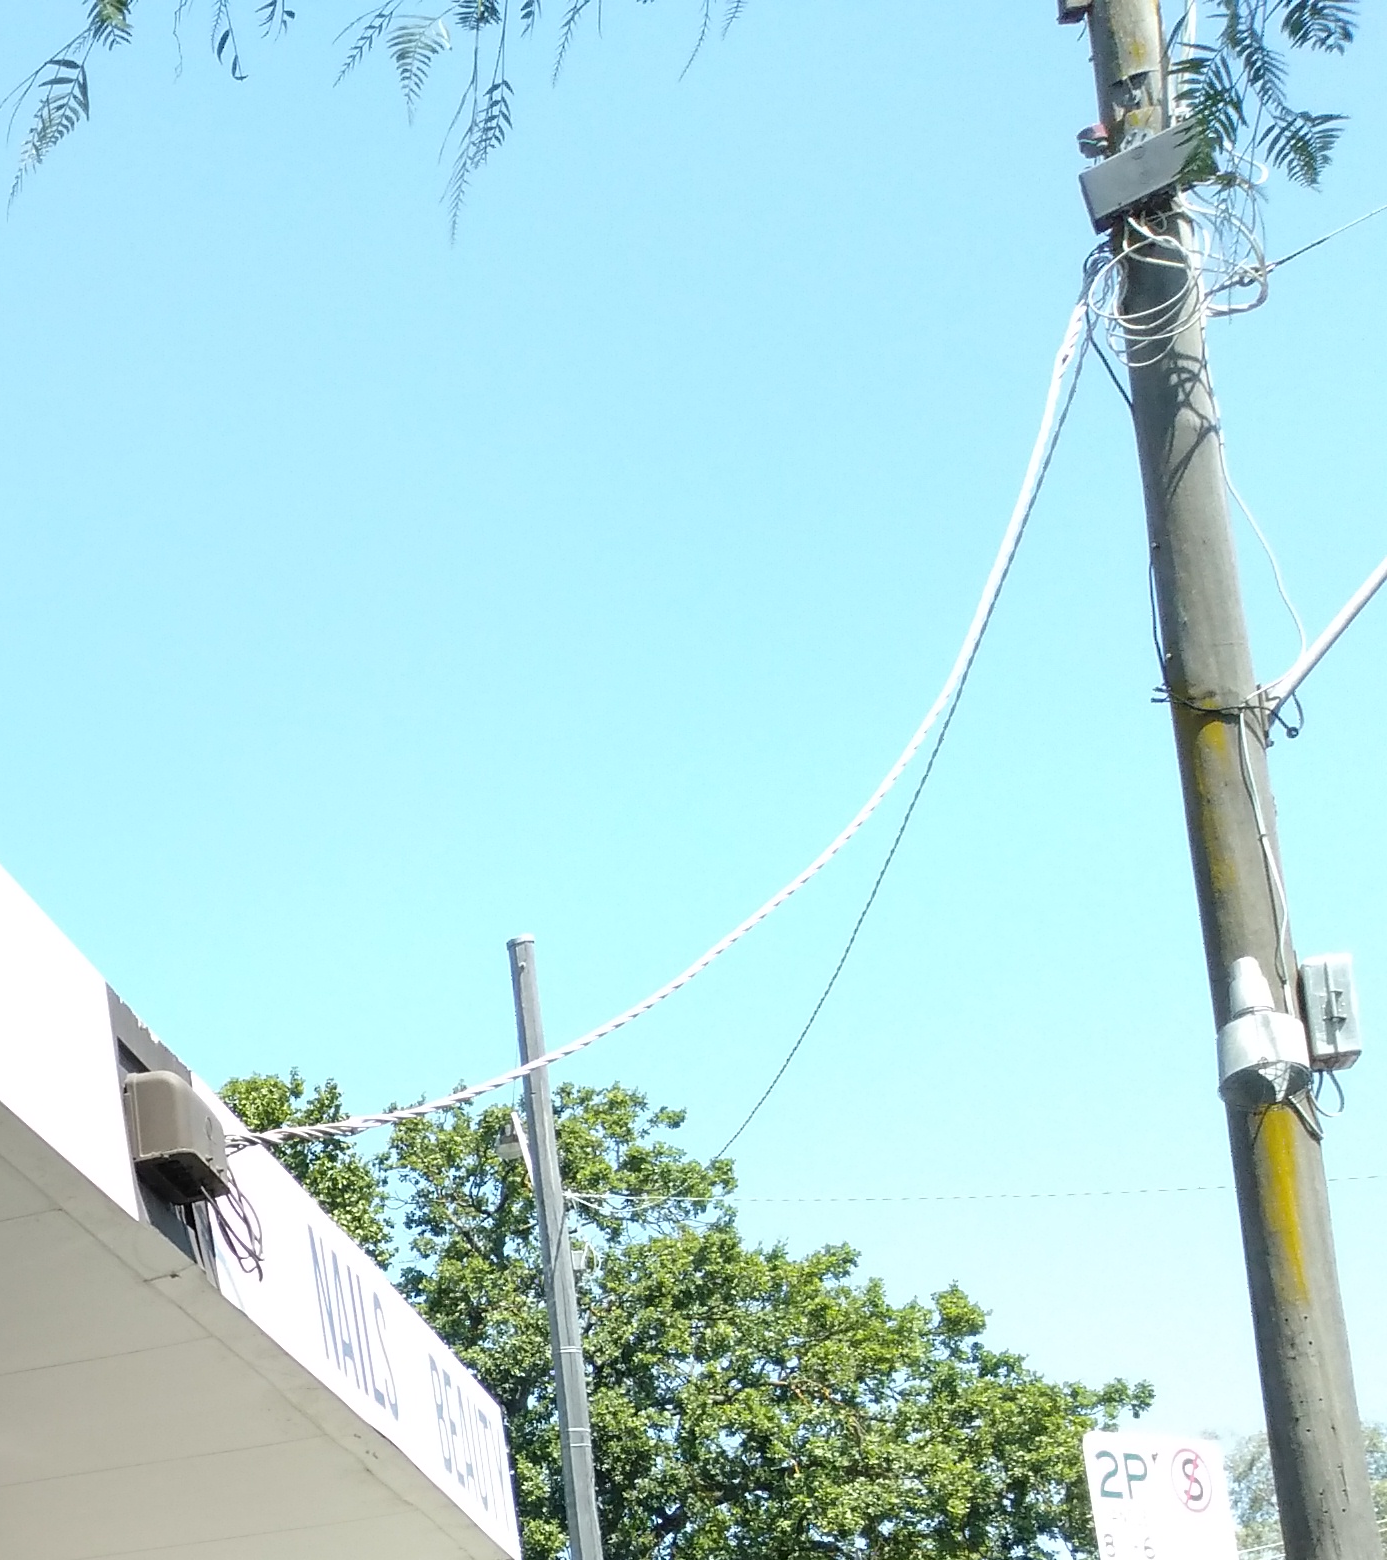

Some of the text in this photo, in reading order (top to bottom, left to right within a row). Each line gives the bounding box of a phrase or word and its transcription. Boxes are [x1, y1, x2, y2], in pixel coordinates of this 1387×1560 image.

[306, 1223, 513, 1530] NAILS BEAUTY
[1095, 1450, 1148, 1500] 2P
